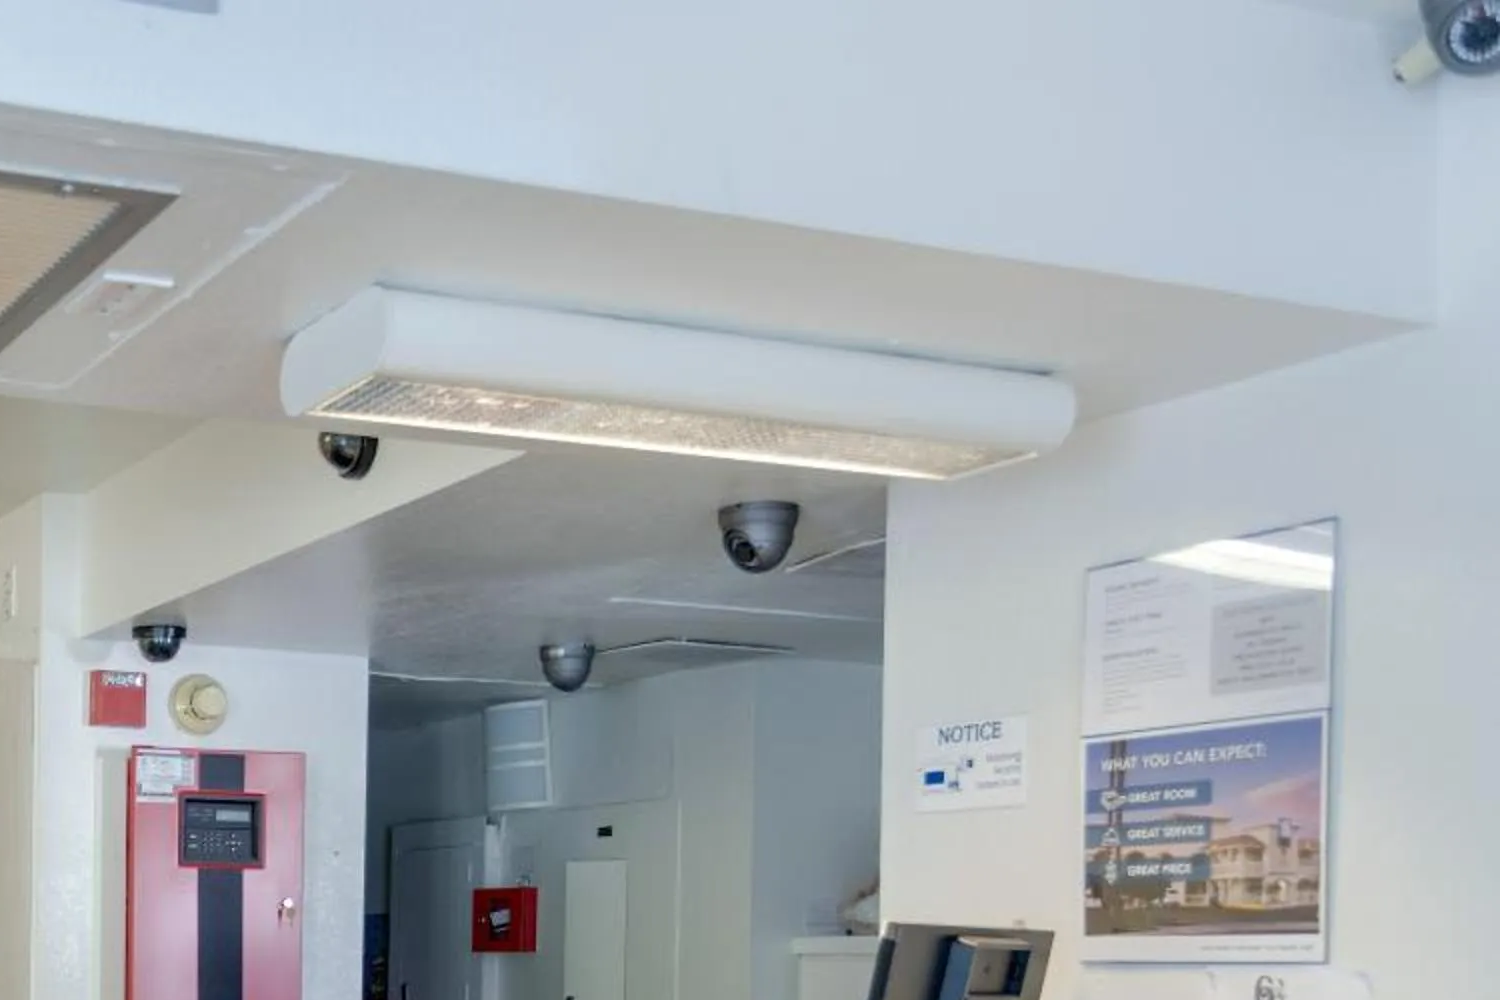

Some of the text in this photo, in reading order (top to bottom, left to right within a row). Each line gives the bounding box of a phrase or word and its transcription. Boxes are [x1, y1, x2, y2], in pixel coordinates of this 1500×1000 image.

[938, 721, 1003, 745] NOTICE
[1101, 742, 1267, 772] WHAT YOU CAN EXPECT:
[1128, 791, 1160, 803] GREAT
[1127, 825, 1205, 840] GREAT SERVICE
[1127, 865, 1160, 877] GREAT
